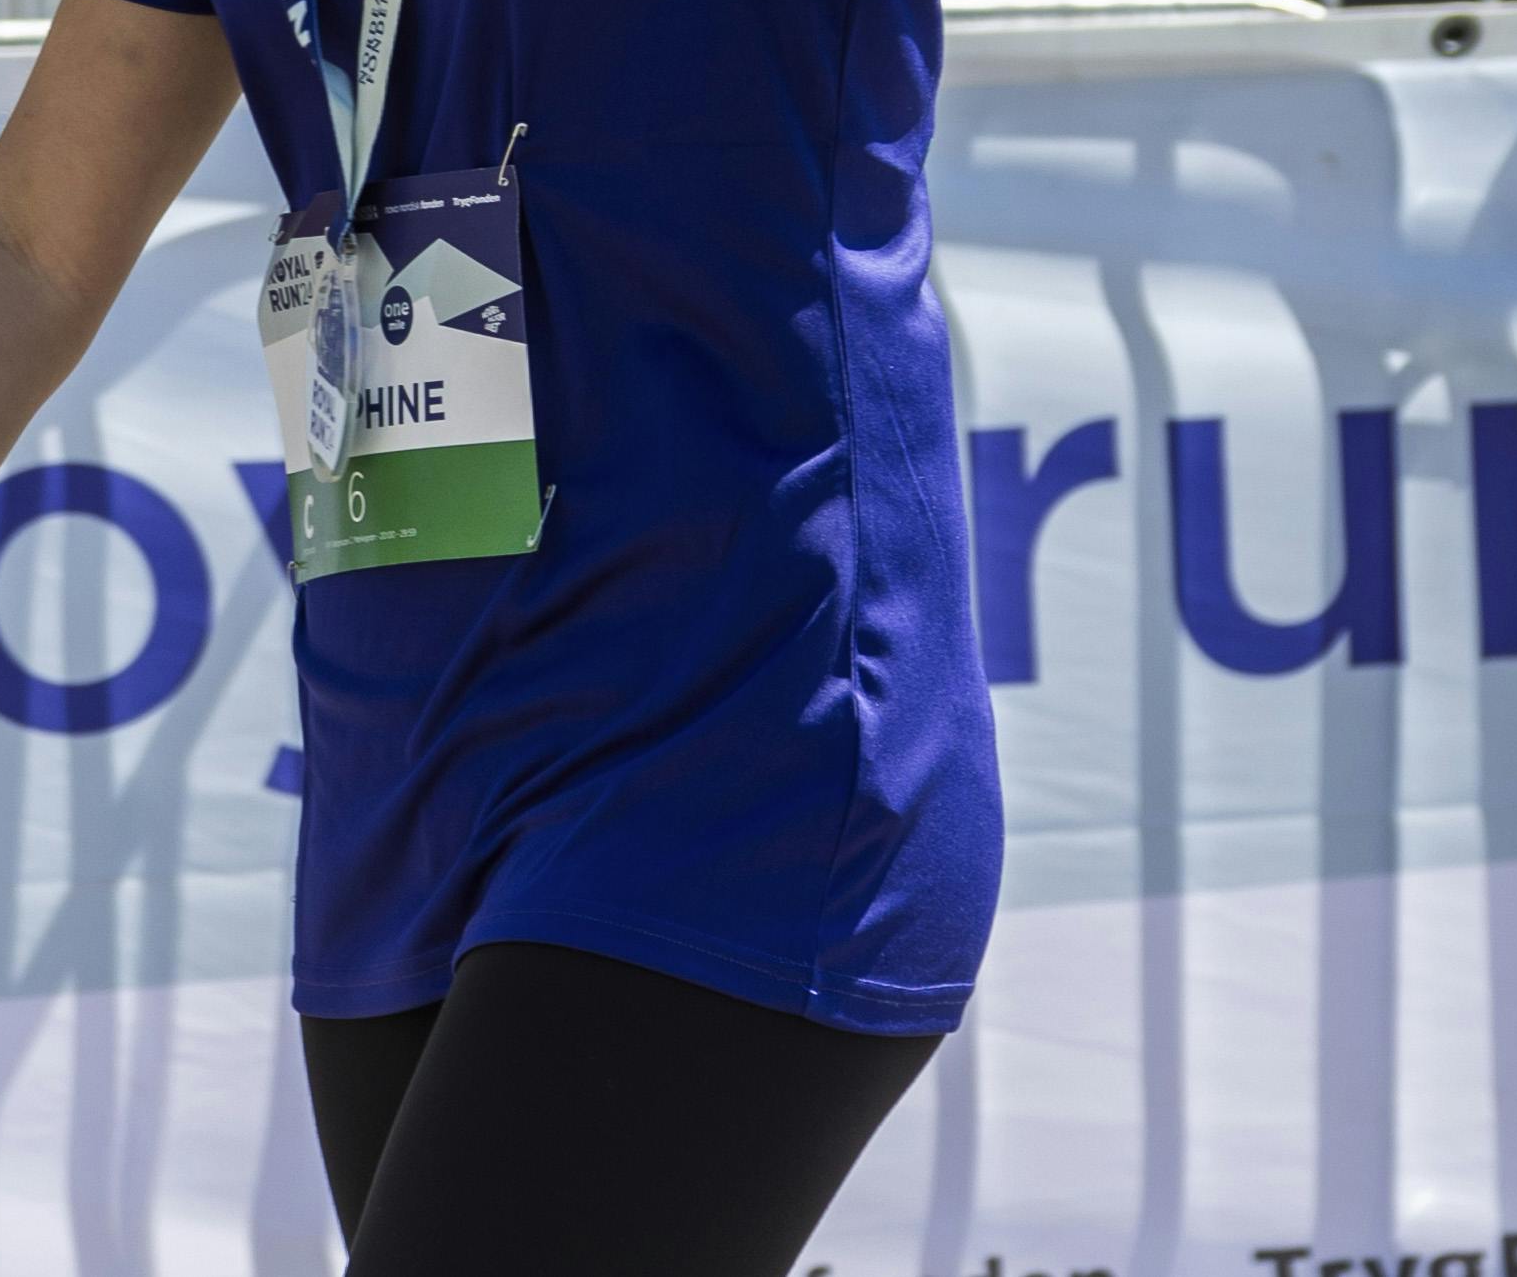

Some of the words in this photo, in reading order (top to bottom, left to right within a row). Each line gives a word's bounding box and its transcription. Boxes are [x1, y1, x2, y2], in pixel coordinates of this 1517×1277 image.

[384, 300, 410, 319] one
[388, 320, 406, 331] mile
[348, 471, 366, 522] 6
